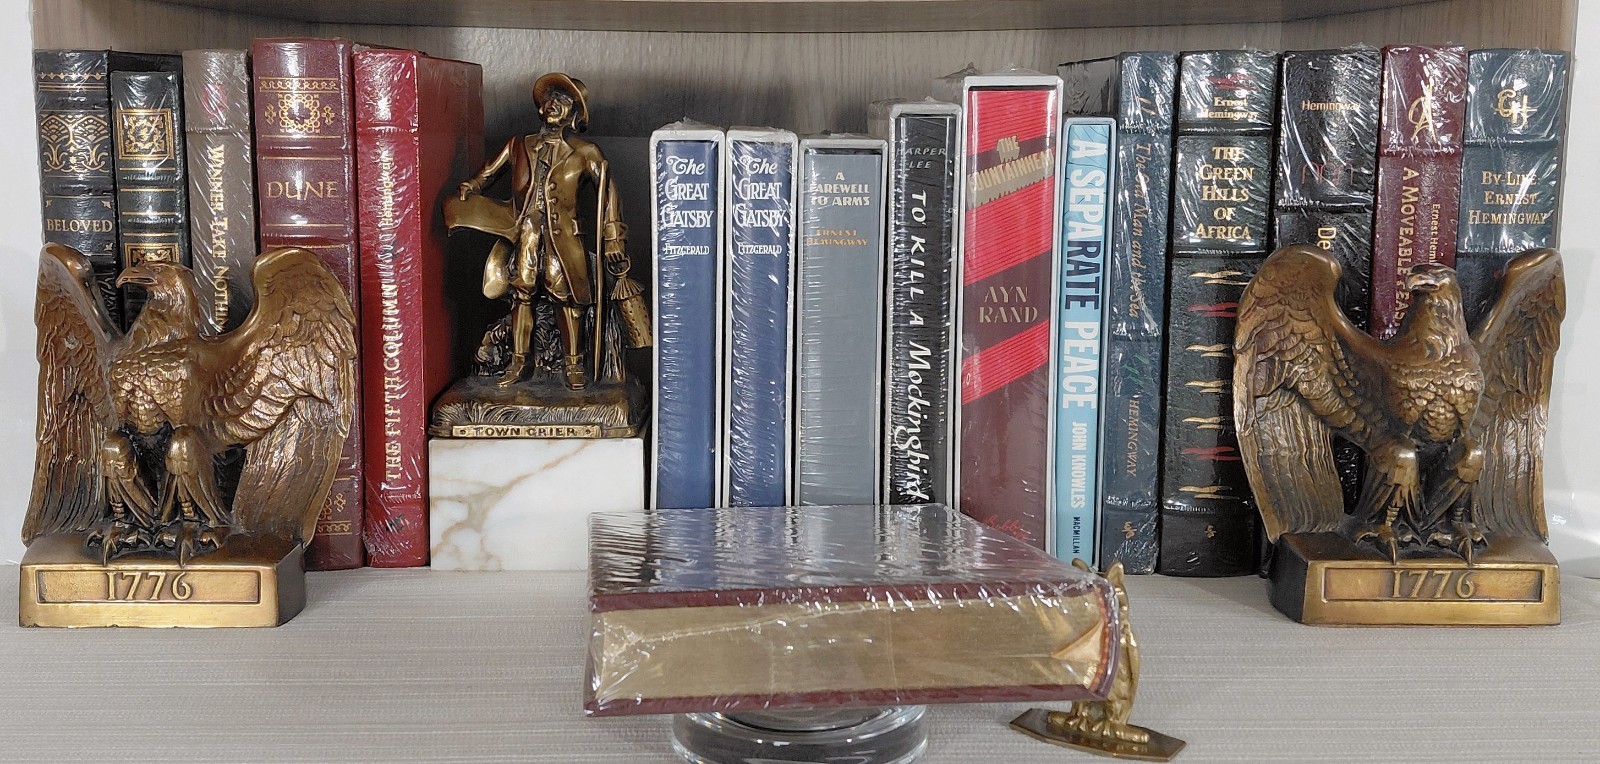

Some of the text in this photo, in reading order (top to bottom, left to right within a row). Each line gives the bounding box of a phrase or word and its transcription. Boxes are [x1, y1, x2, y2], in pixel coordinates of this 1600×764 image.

[1213, 96, 1249, 107] Ernest
[1301, 100, 1361, 113] Hemingway
[1201, 109, 1258, 120] Hemingway
[896, 147, 947, 157] HARPER
[998, 135, 1019, 153] THE
[1212, 146, 1245, 160] THE
[740, 155, 778, 175] The
[909, 160, 932, 169] LEE
[1135, 143, 1152, 169] The
[666, 155, 706, 176] The
[967, 149, 1054, 192] FOUNTAINHEAD
[1199, 164, 1255, 181] GREEN
[1402, 167, 1420, 181] A
[835, 171, 845, 181] A
[267, 180, 340, 199] DUNE
[665, 176, 710, 201] GREAT
[739, 177, 782, 200] GREAT
[809, 183, 870, 194] FAREWELL
[1201, 185, 1250, 202] HILLS
[1483, 190, 1538, 205] ERNEST
[810, 195, 870, 206] TO ARMS
[661, 203, 714, 228] GATSBY
[734, 203, 787, 228] GATSBY
[1132, 203, 1149, 237] Man
[1213, 207, 1236, 220] OF
[1430, 203, 1441, 236] Ernest
[1469, 209, 1548, 225] HEMINGWAY
[46, 219, 113, 232] BELOVED
[1195, 223, 1252, 240] AFRICA
[1397, 185, 1419, 276] MOVEABLE
[208, 144, 230, 331] WINNER TAKE NOTHIN
[806, 237, 868, 246] HEMINGWAY
[664, 244, 710, 255] FITZGERALD
[738, 243, 782, 255] FITZGERALD
[1132, 240, 1146, 269] and
[1062, 139, 1107, 409] A SEPARATE PEACE
[984, 286, 1028, 303] AYN
[979, 306, 1038, 324] RAND
[894, 189, 932, 500] TO KILL A Mockingbird
[384, 376, 401, 436] FIFTH
[473, 427, 521, 436] TOWN
[1126, 399, 1140, 478] HEMINGWAY
[385, 443, 401, 481] THE
[1070, 421, 1088, 509] JOHN KNOWLES
[1072, 516, 1081, 554] MACMILLAN
[106, 571, 192, 600] 1776
[1392, 569, 1476, 599] 1776
